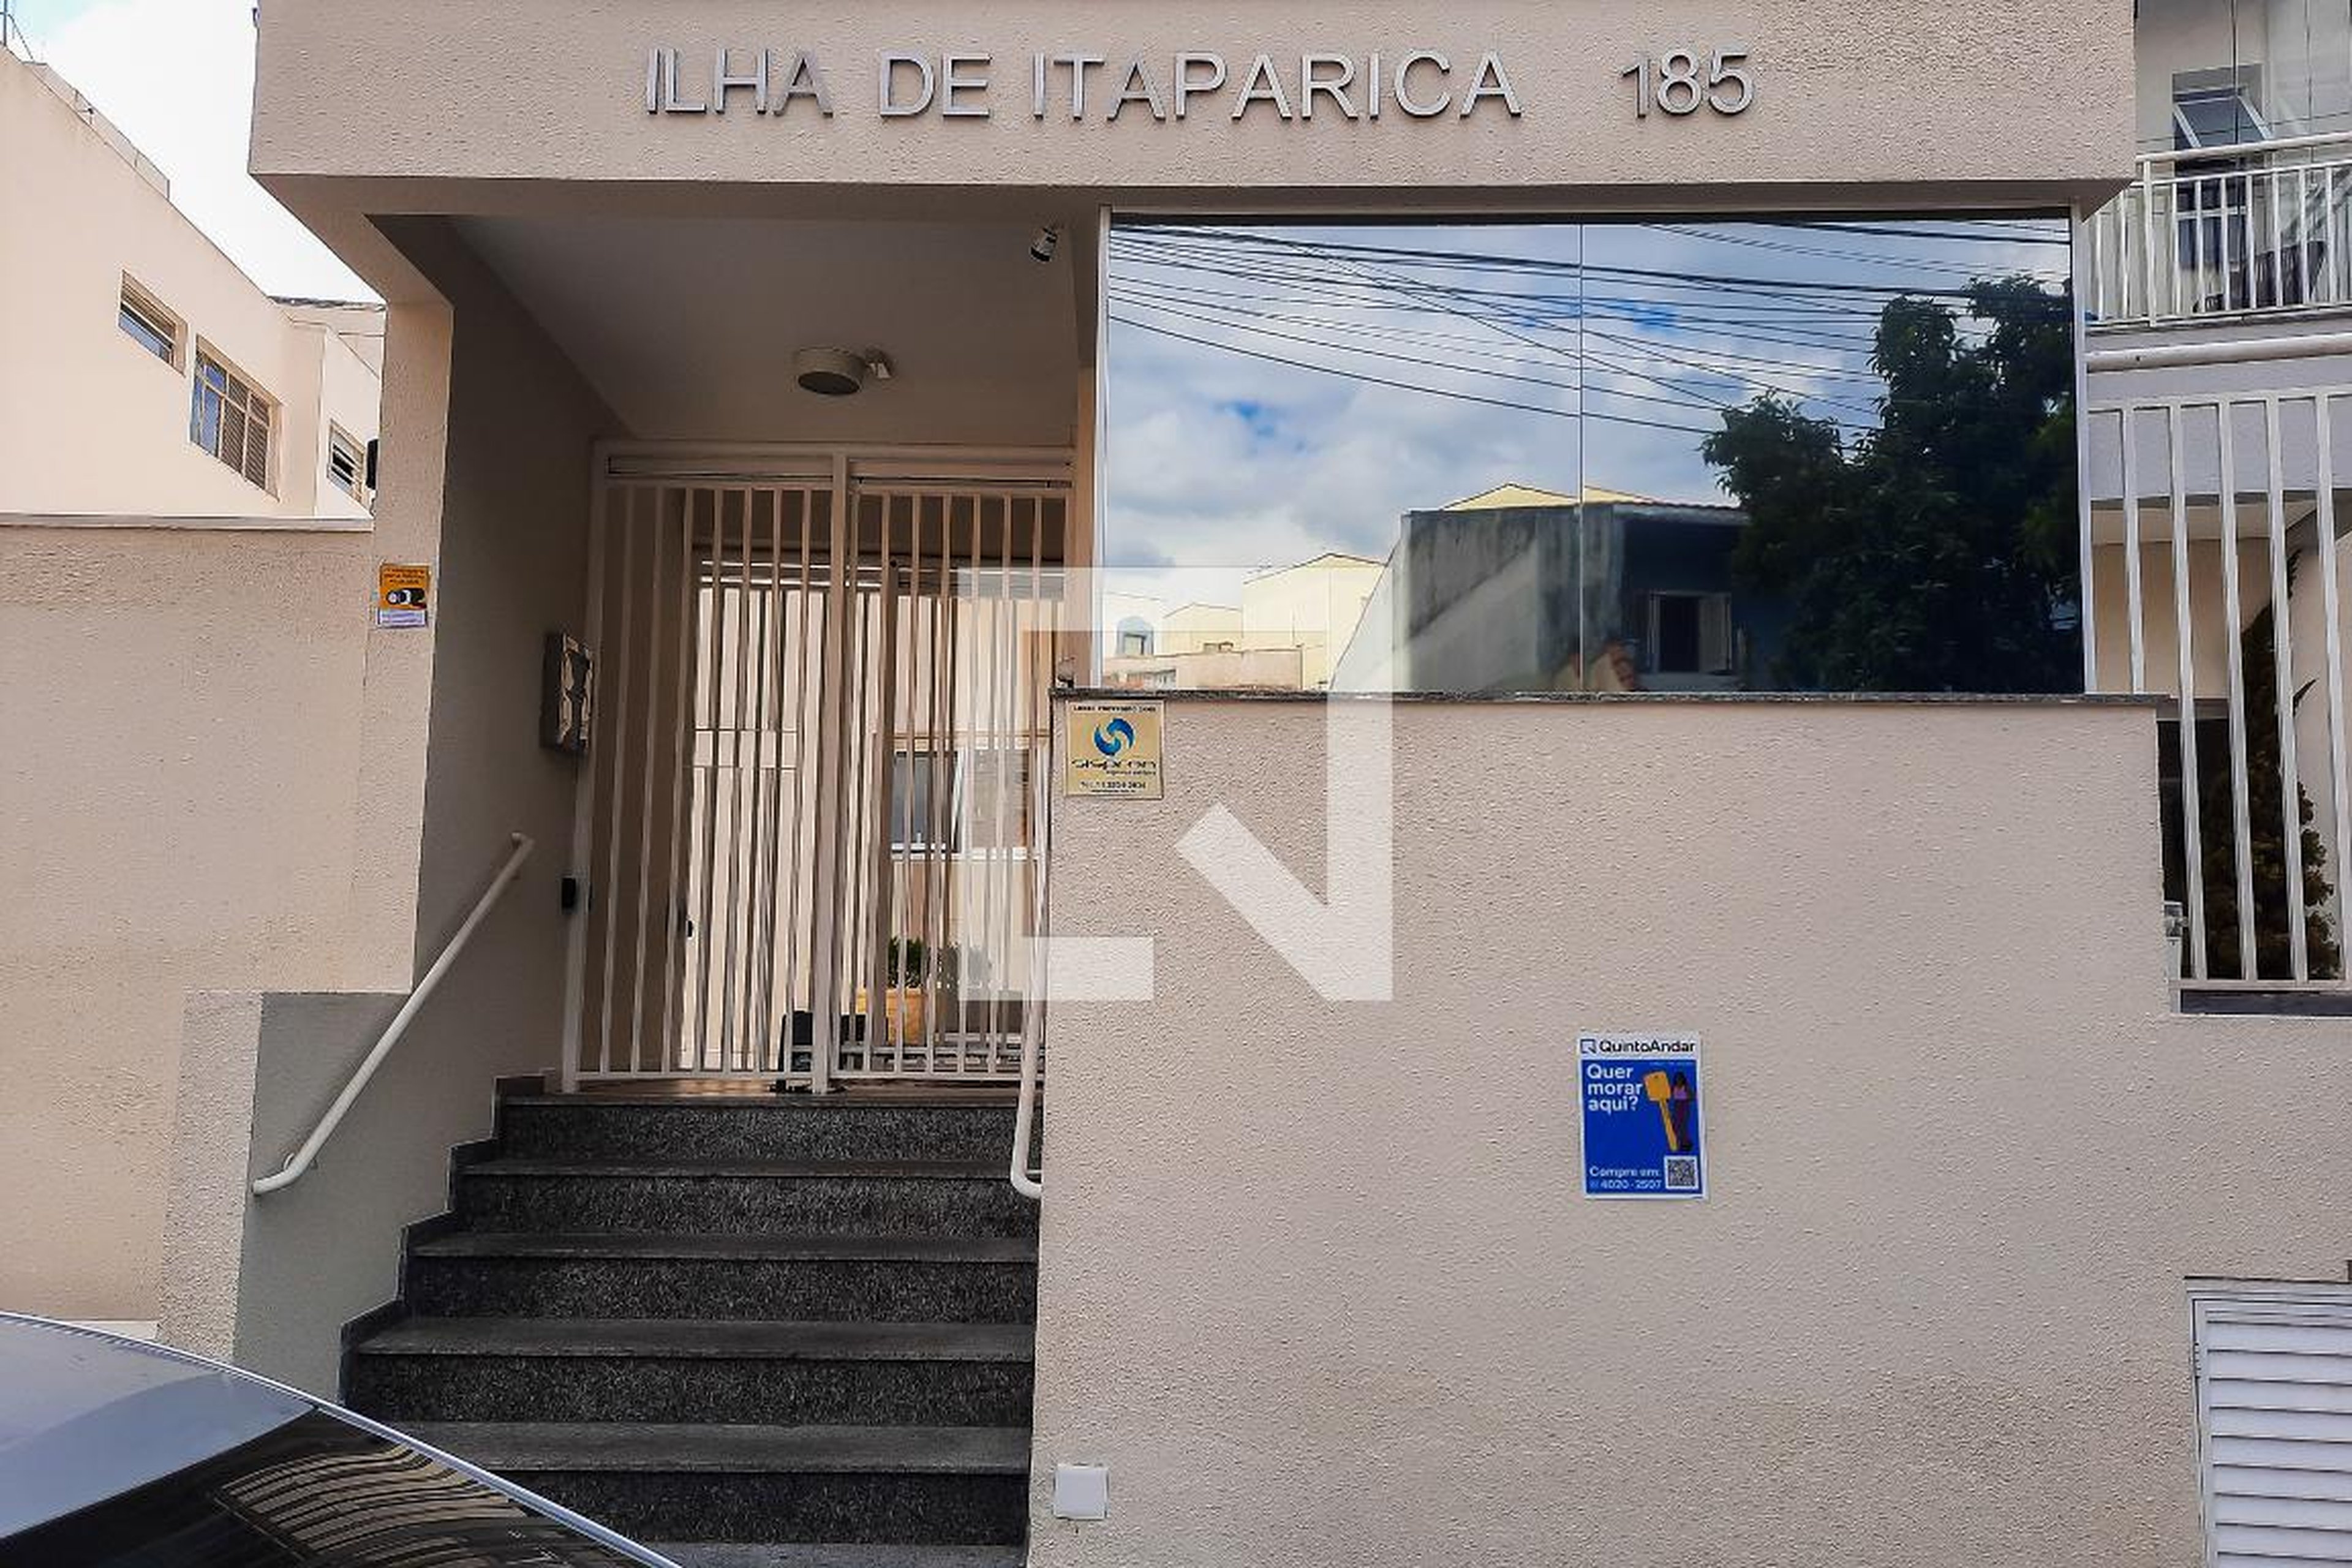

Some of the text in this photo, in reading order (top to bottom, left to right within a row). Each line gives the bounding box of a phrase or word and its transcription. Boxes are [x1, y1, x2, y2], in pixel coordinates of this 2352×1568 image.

[646, 47, 1754, 121] ILHA DE ITAPARICA 185
[1599, 1039, 1696, 1053] QuintoAndar
[1586, 1063, 1634, 1080] Quer
[1587, 1082, 1643, 1096] morar
[1588, 1095, 1639, 1115] aqui?
